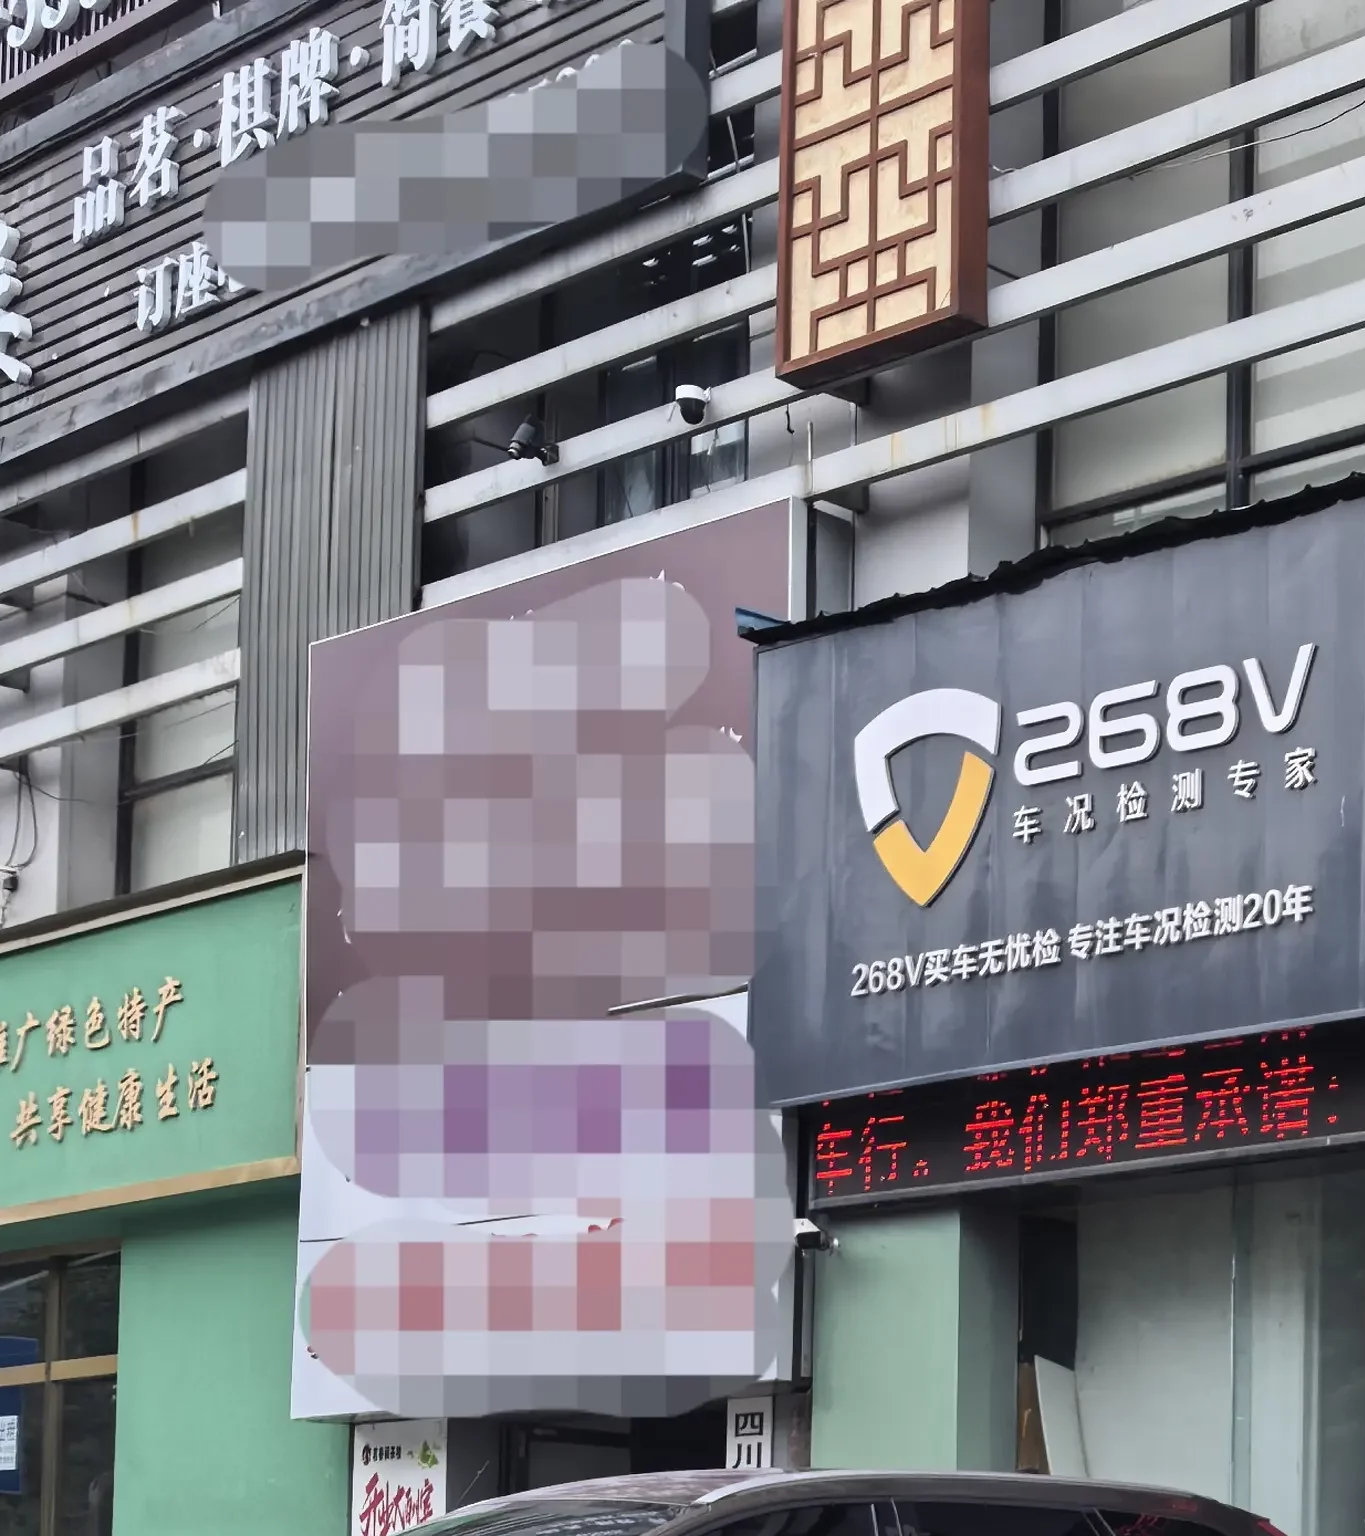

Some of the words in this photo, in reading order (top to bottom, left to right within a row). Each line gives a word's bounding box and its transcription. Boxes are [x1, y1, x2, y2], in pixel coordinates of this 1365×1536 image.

[133, 241, 246, 331] 订座
[1013, 643, 1318, 786] 268V
[1012, 746, 1318, 844] 车况检测专家
[850, 928, 1061, 998] 268V买车无忧检
[1067, 884, 1315, 959] 专注车况检测20年
[10, 1057, 219, 1149] 共享健康生活
